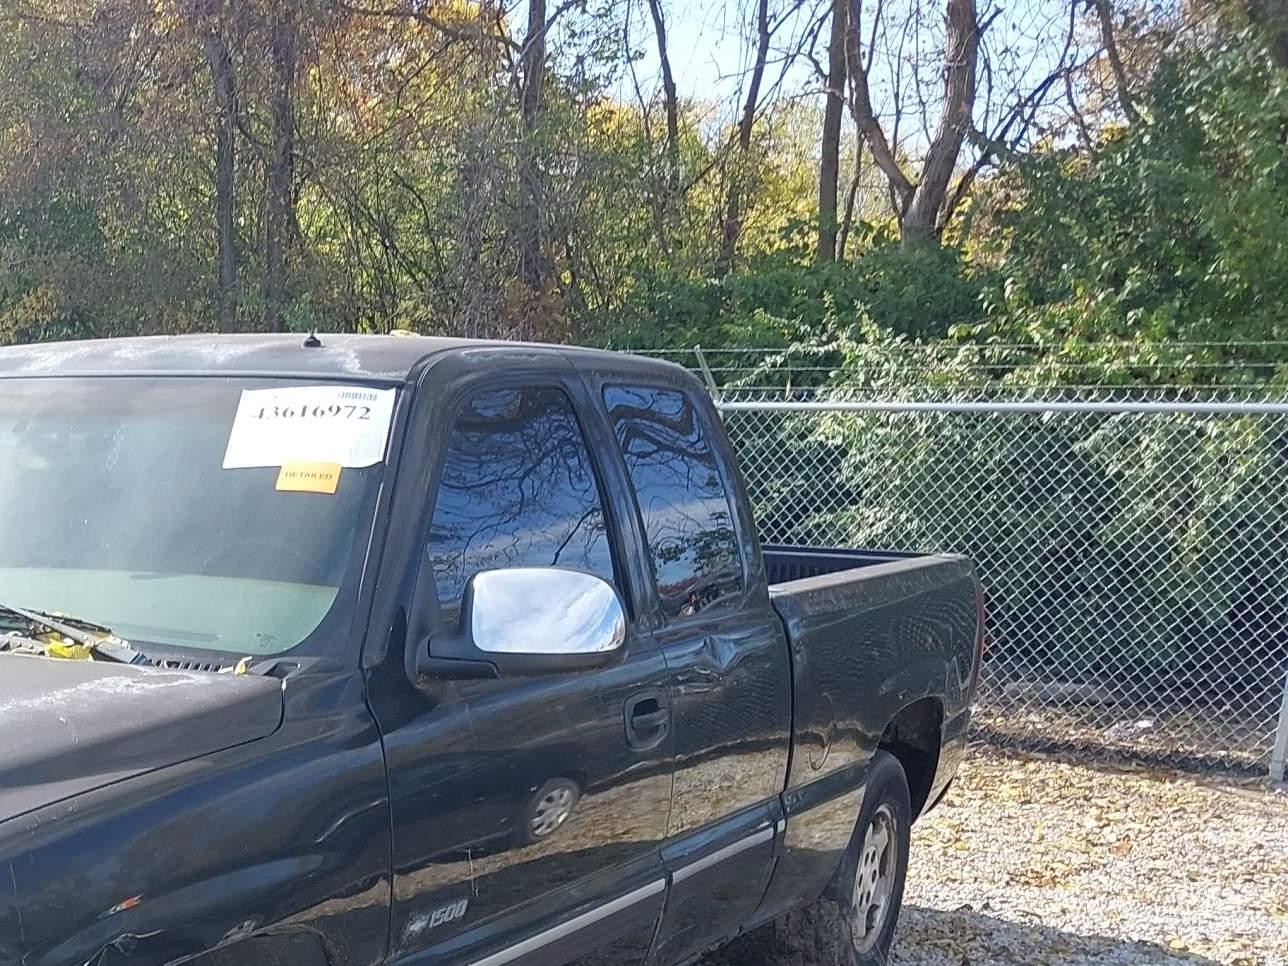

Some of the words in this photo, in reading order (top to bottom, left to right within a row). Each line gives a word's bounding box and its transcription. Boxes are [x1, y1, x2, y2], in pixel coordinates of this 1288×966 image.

[252, 404, 371, 421] 43616972
[284, 471, 333, 480] DETAILED
[429, 899, 468, 928] 1500
